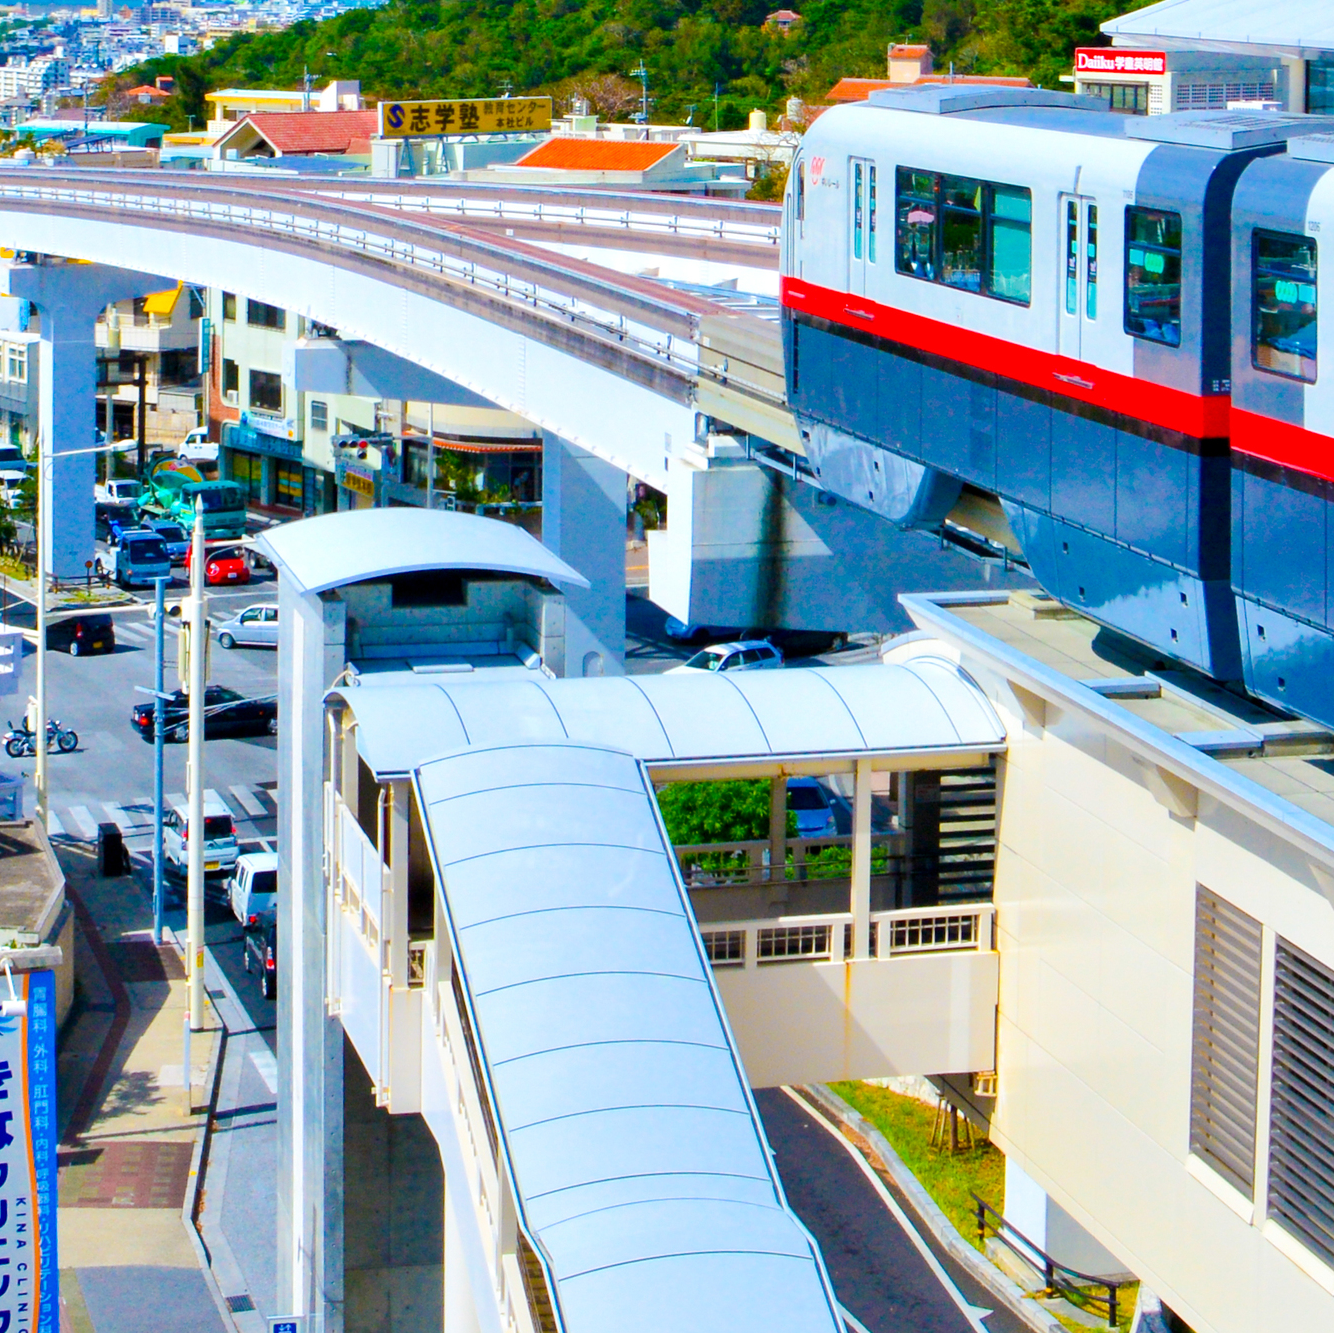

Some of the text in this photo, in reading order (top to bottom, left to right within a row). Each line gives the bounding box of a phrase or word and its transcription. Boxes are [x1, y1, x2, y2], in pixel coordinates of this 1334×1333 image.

[409, 102, 481, 132] 志学塾
[483, 100, 547, 115] 教育センター
[496, 116, 534, 129] 本社ビル
[16, 1197, 28, 1249] KINA
